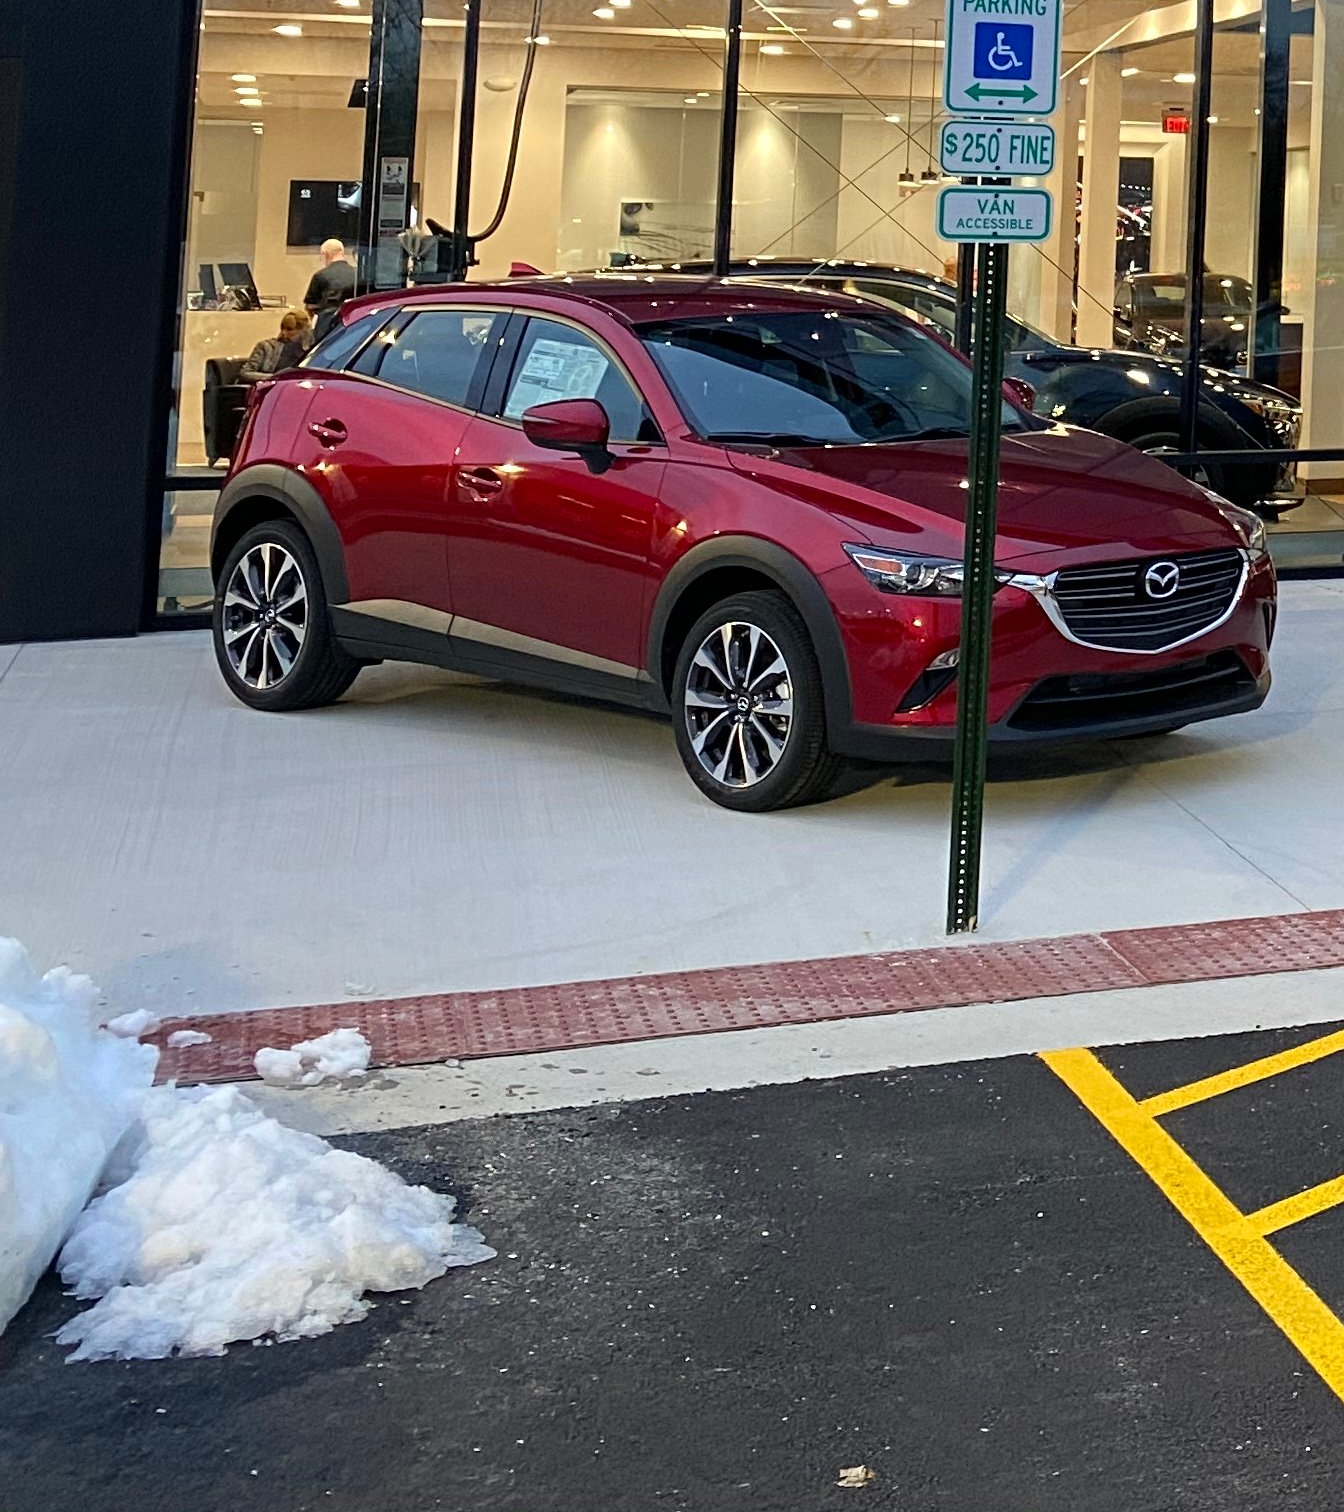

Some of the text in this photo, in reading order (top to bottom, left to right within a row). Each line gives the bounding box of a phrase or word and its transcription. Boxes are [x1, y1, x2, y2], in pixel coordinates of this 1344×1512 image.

[945, 132, 1051, 165] $250 FINE
[977, 199, 1015, 216] VAN
[956, 217, 1033, 230] ACCESSIBLE
